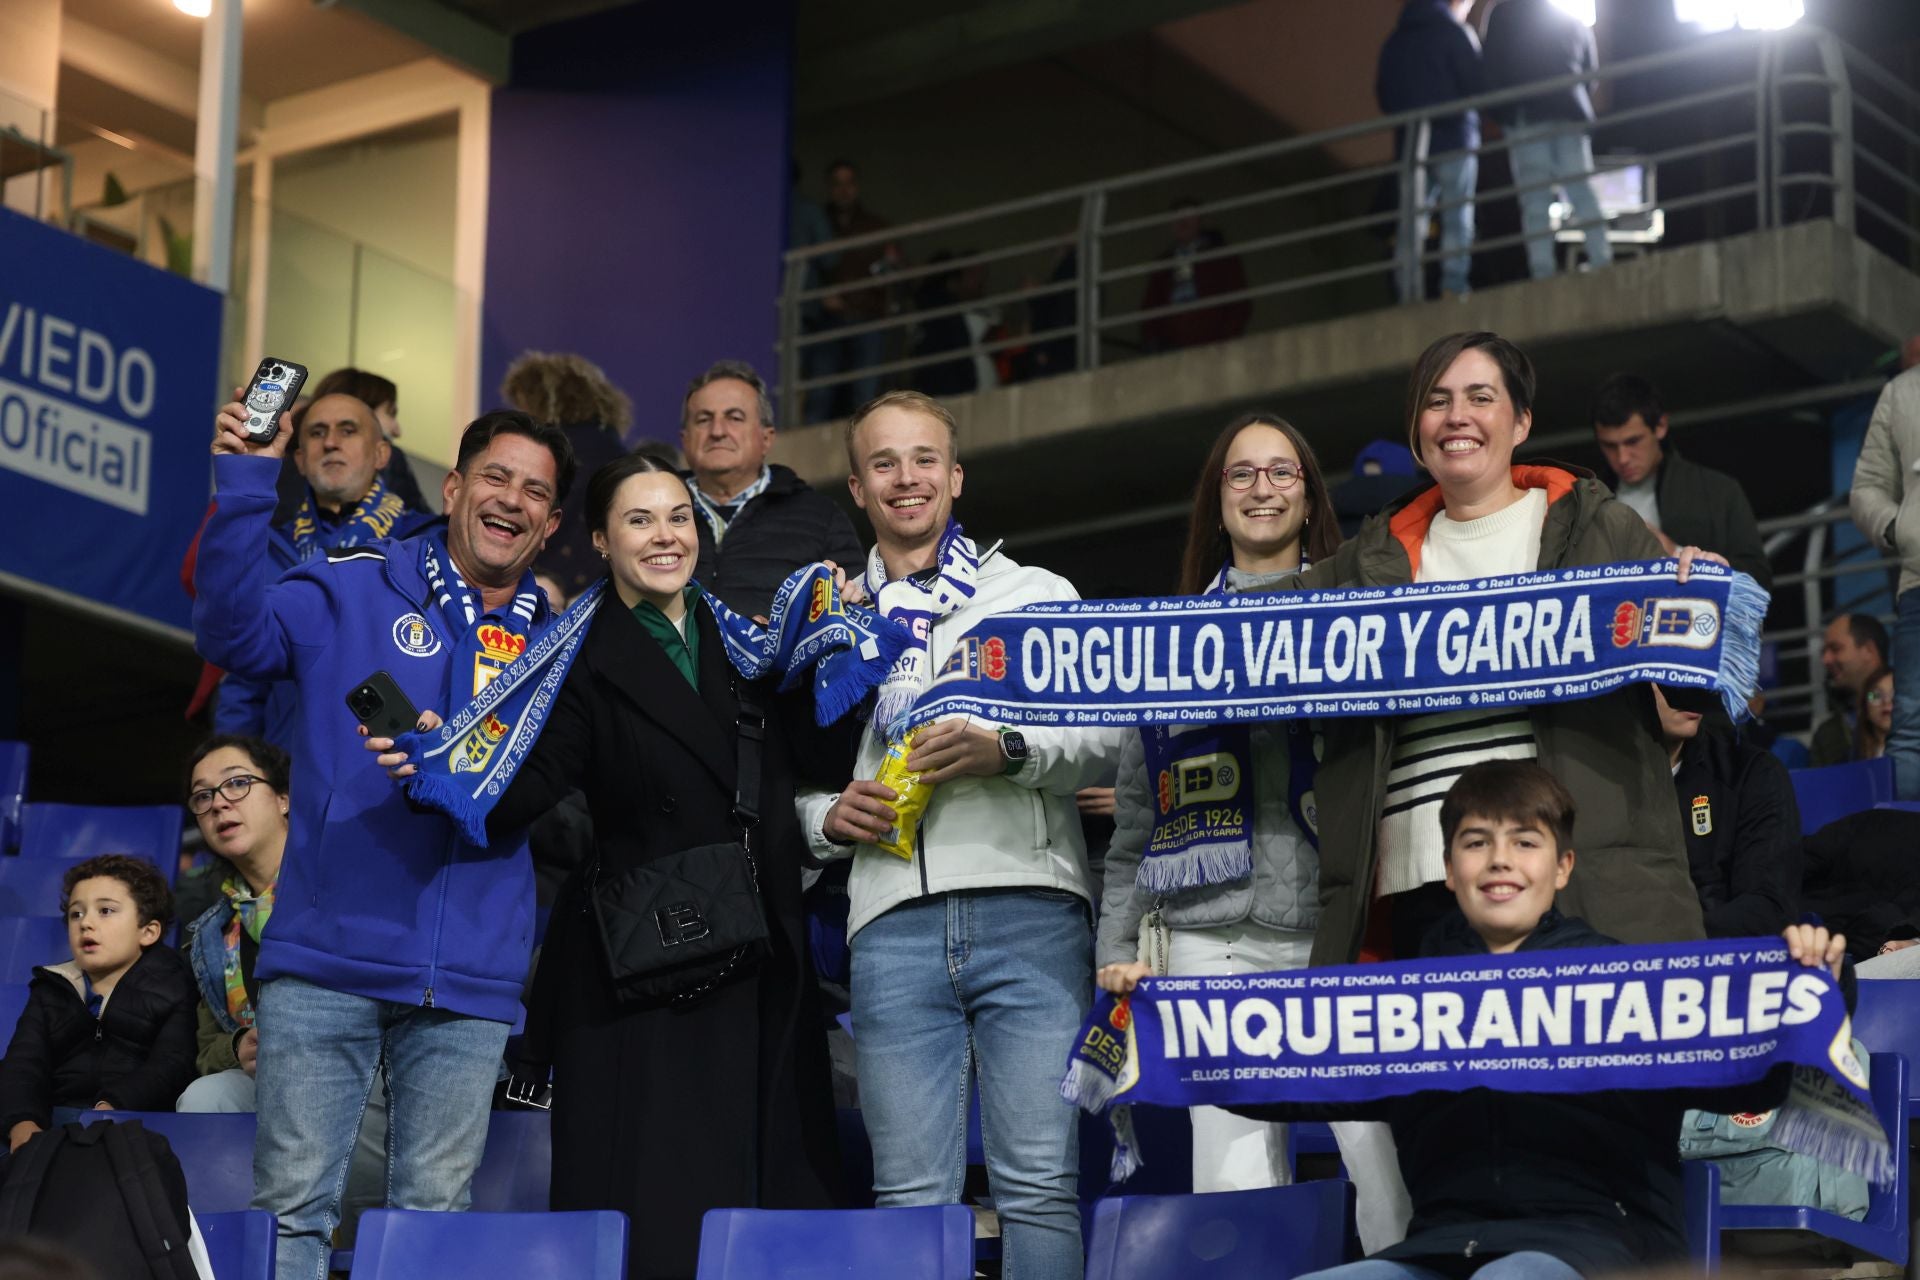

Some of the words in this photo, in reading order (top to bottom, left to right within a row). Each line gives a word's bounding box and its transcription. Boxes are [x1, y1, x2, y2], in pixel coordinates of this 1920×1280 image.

[1, 394, 140, 494] Oficial
[1576, 568, 1600, 580] Real
[1604, 565, 1643, 576] Oviedo
[1405, 586, 1428, 595] Real
[1432, 583, 1469, 593] Oviedo
[1490, 577, 1514, 588] Real
[1518, 574, 1556, 585] Oviedo
[769, 578, 796, 623] DESDE
[1241, 597, 1263, 607] Real
[1267, 596, 1303, 605] Oviedo
[1322, 591, 1345, 601] Real
[1349, 590, 1386, 600] Oviedo
[1080, 603, 1103, 612] Real
[1106, 603, 1141, 611] Oviedo
[1160, 601, 1182, 610] Real
[1186, 599, 1222, 608] Oviedo
[763, 628, 779, 655] 1926
[821, 629, 848, 647] 1926
[1021, 623, 1235, 694] ORGULLO,
[1240, 613, 1387, 686] VALOR
[1400, 610, 1432, 678] Y
[1437, 594, 1595, 676] GARRA
[525, 637, 551, 667] DESDE
[1566, 682, 1588, 695] Real
[1591, 675, 1624, 691] Oviedo
[1641, 669, 1665, 680] Real
[1668, 671, 1707, 685] Oviedo
[470, 679, 505, 714] DESDE
[1399, 698, 1421, 709] Real
[1424, 695, 1462, 707] Oviedo
[1481, 691, 1505, 703] Real
[1508, 688, 1546, 700] Oviedo
[924, 705, 944, 718] Real
[947, 702, 983, 714] Oviedo
[1155, 710, 1177, 720] Real
[1180, 708, 1217, 719] Oviedo
[1236, 706, 1259, 718] Real
[1262, 704, 1296, 716] Oviedo
[1316, 702, 1338, 713] Real
[1342, 700, 1379, 711] Oviedo
[452, 708, 473, 733] 1926
[1001, 710, 1022, 721] Real
[1026, 711, 1059, 721] Oviedo
[1077, 711, 1099, 722] Real
[1102, 711, 1137, 721] Oviedo
[512, 717, 538, 760] DESDE
[496, 755, 516, 784] 1926
[1152, 811, 1198, 843] DESDE
[1204, 808, 1243, 827] 1926
[1139, 981, 1150, 991] Y
[1156, 980, 1200, 991] SOBRE
[1204, 979, 1247, 991] TODO,
[1249, 978, 1305, 989] PORQUE
[1310, 977, 1340, 988] POR
[1343, 975, 1396, 987] ENCIMA
[1401, 973, 1420, 984] DE
[1424, 969, 1502, 984] CUALQUIER
[1507, 967, 1552, 980] COSA,
[1556, 964, 1587, 977] HAY
[1588, 961, 1630, 975] ALGO
[1632, 958, 1664, 972] QUE
[1668, 955, 1700, 970] NOS
[1704, 953, 1735, 967] UNE
[1739, 952, 1751, 965] Y
[1755, 950, 1787, 964] NOS
[1156, 971, 1830, 1060] INQUEBRANTABLES
[1234, 1067, 1307, 1080] DEFIENDEN
[1311, 1064, 1382, 1078] NUESTROS
[1453, 1060, 1465, 1071] Y
[1469, 1057, 1555, 1070] NOSOTROS,
[1558, 1053, 1653, 1070] DEFENDEMOS
[1657, 1049, 1724, 1065] NUESTRO
[1729, 1040, 1778, 1060] ESCUDO
